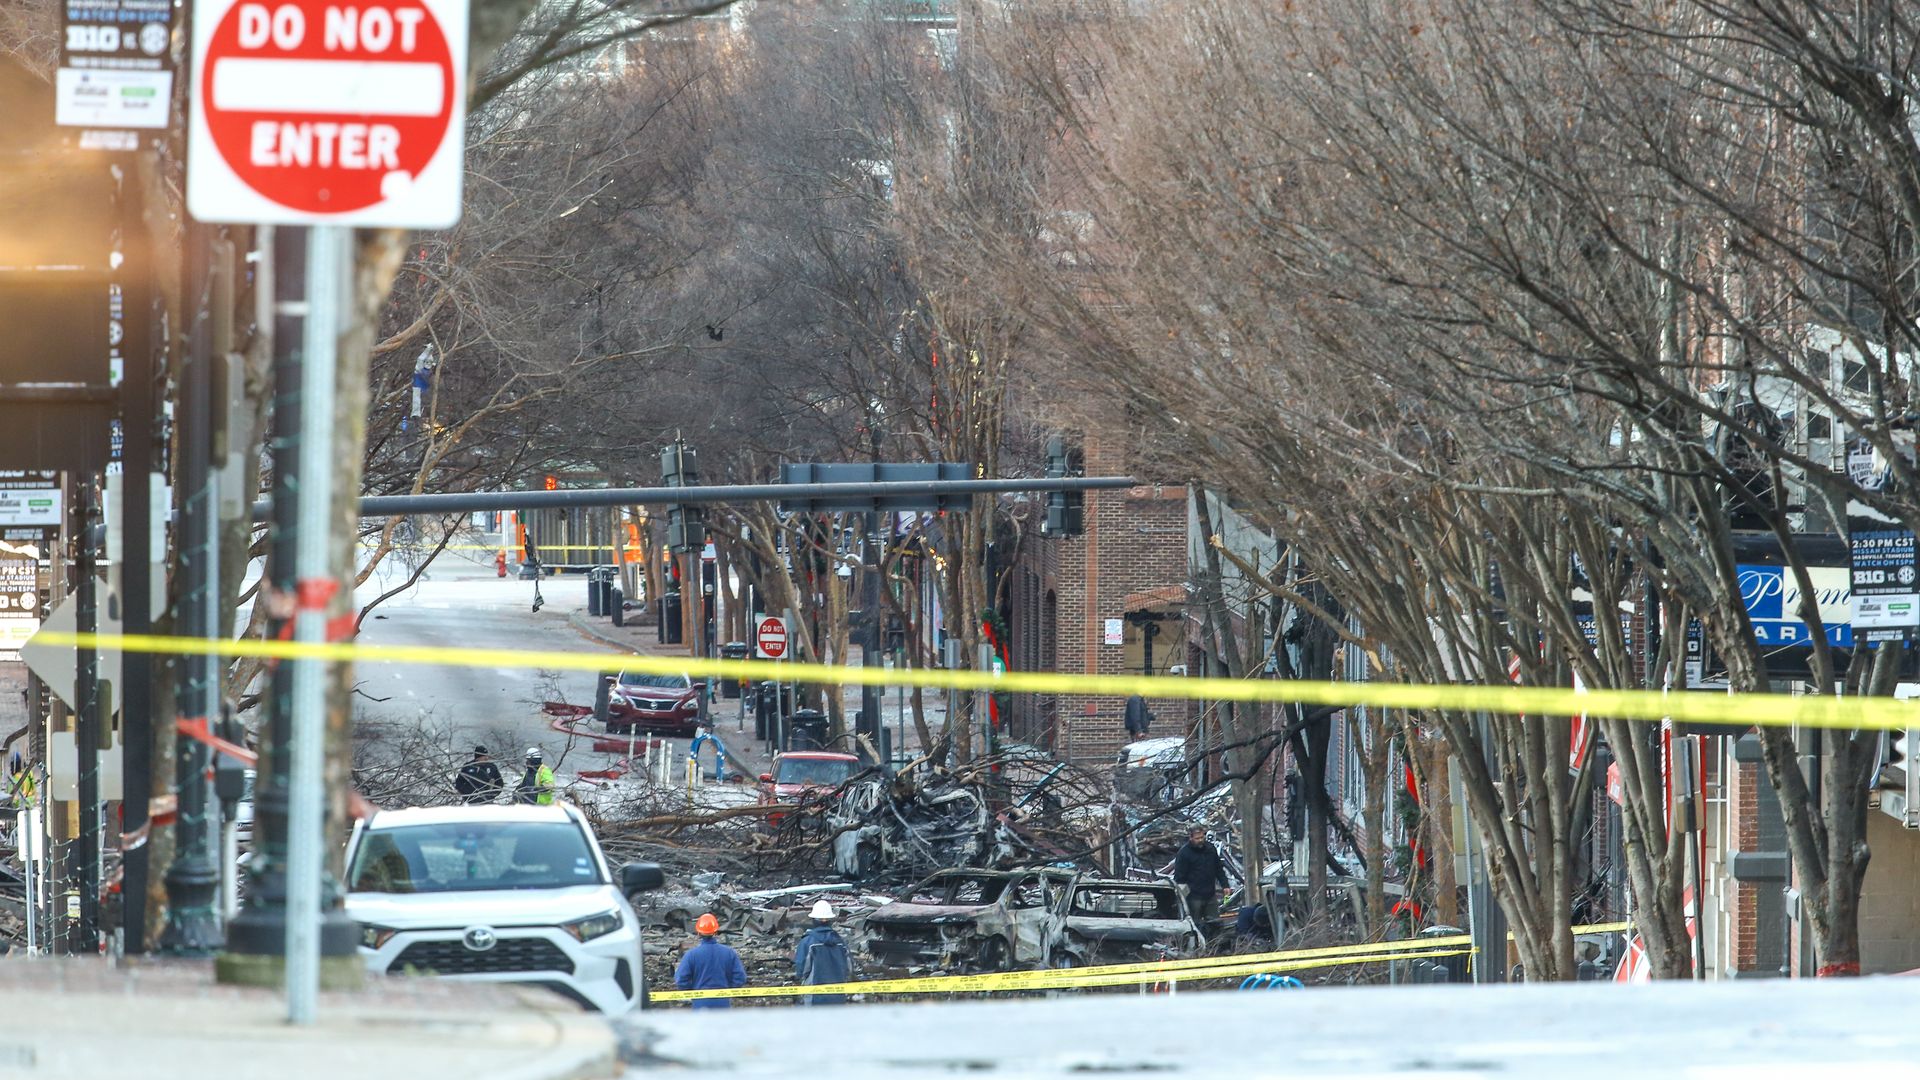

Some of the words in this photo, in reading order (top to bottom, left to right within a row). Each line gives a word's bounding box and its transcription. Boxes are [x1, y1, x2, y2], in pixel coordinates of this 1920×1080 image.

[238, 3, 305, 50] DO
[324, 6, 424, 53] NOT
[251, 120, 401, 169] ENTER
[1852, 540, 1876, 548] 2:30
[1878, 539, 1893, 547] PM
[1895, 538, 1914, 546] CST
[2, 567, 17, 575] PM
[18, 567, 36, 575] CST
